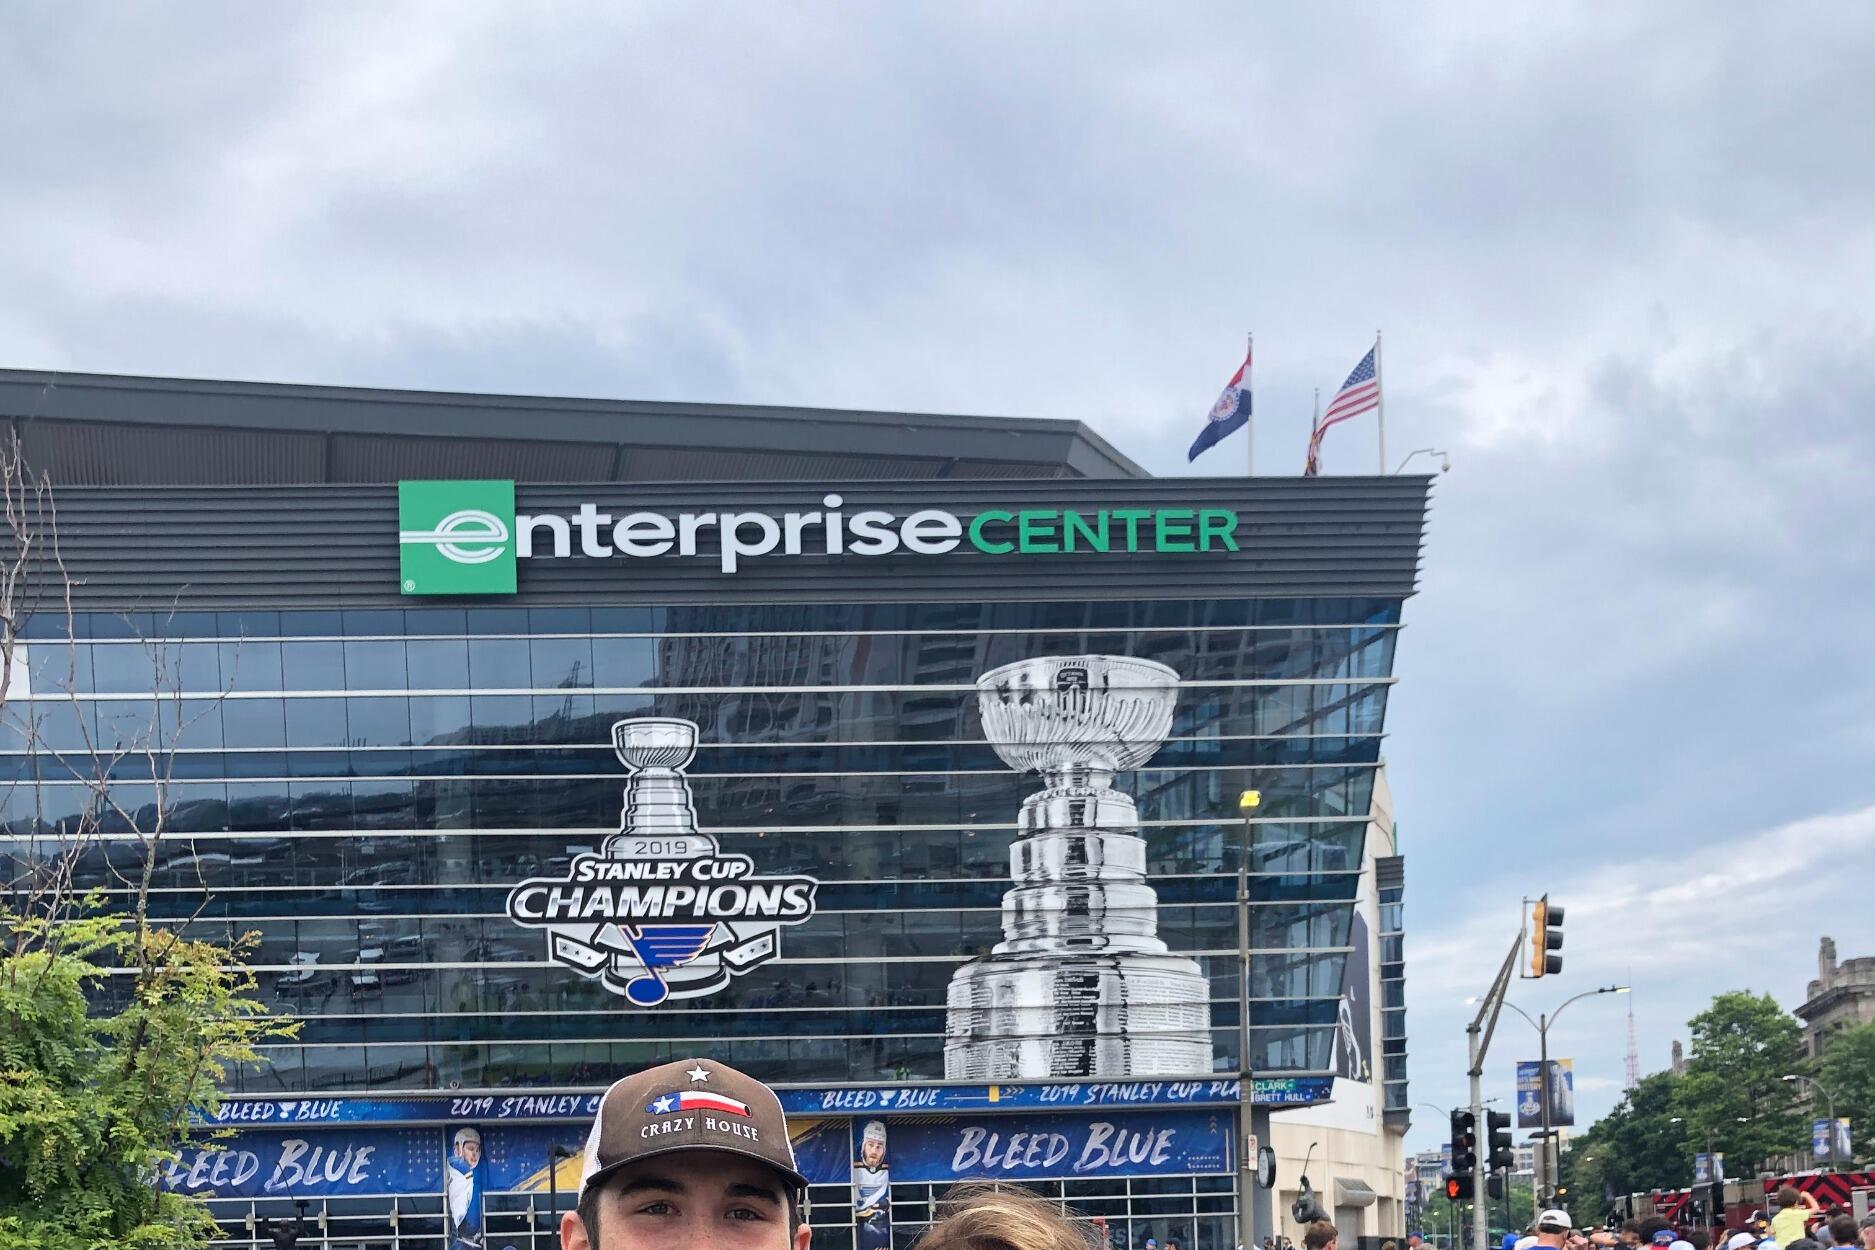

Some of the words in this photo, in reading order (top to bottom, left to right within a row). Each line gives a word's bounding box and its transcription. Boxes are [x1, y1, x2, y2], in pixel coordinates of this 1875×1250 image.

[400, 494, 962, 574] enterprise
[968, 508, 1240, 553] CENTER
[634, 841, 688, 855] 2019
[576, 861, 690, 881] STANLEY
[692, 860, 748, 881] CUP
[513, 884, 817, 918] CHAMPIONS
[1040, 1083, 1081, 1101] 2019
[1084, 1080, 1162, 1104] STANLEY
[1167, 1080, 1203, 1101] CUP
[1209, 1080, 1240, 1100] PLA
[1254, 1092, 1281, 1102] BRETT
[1284, 1092, 1305, 1102] HULL
[1255, 1081, 1287, 1091] CLARK
[451, 1097, 494, 1116] 2019
[498, 1095, 582, 1118] STANLEY
[821, 1090, 877, 1109] BLEED
[895, 1088, 941, 1108] BLUE
[217, 1102, 275, 1121] BLEED
[294, 1100, 344, 1121] BLUE
[640, 1117, 695, 1139] CRAZY
[705, 1117, 760, 1142] HOUSE
[951, 1126, 1069, 1173] BLEED
[1074, 1122, 1177, 1173] BLUE
[263, 1138, 376, 1193] BLUE
